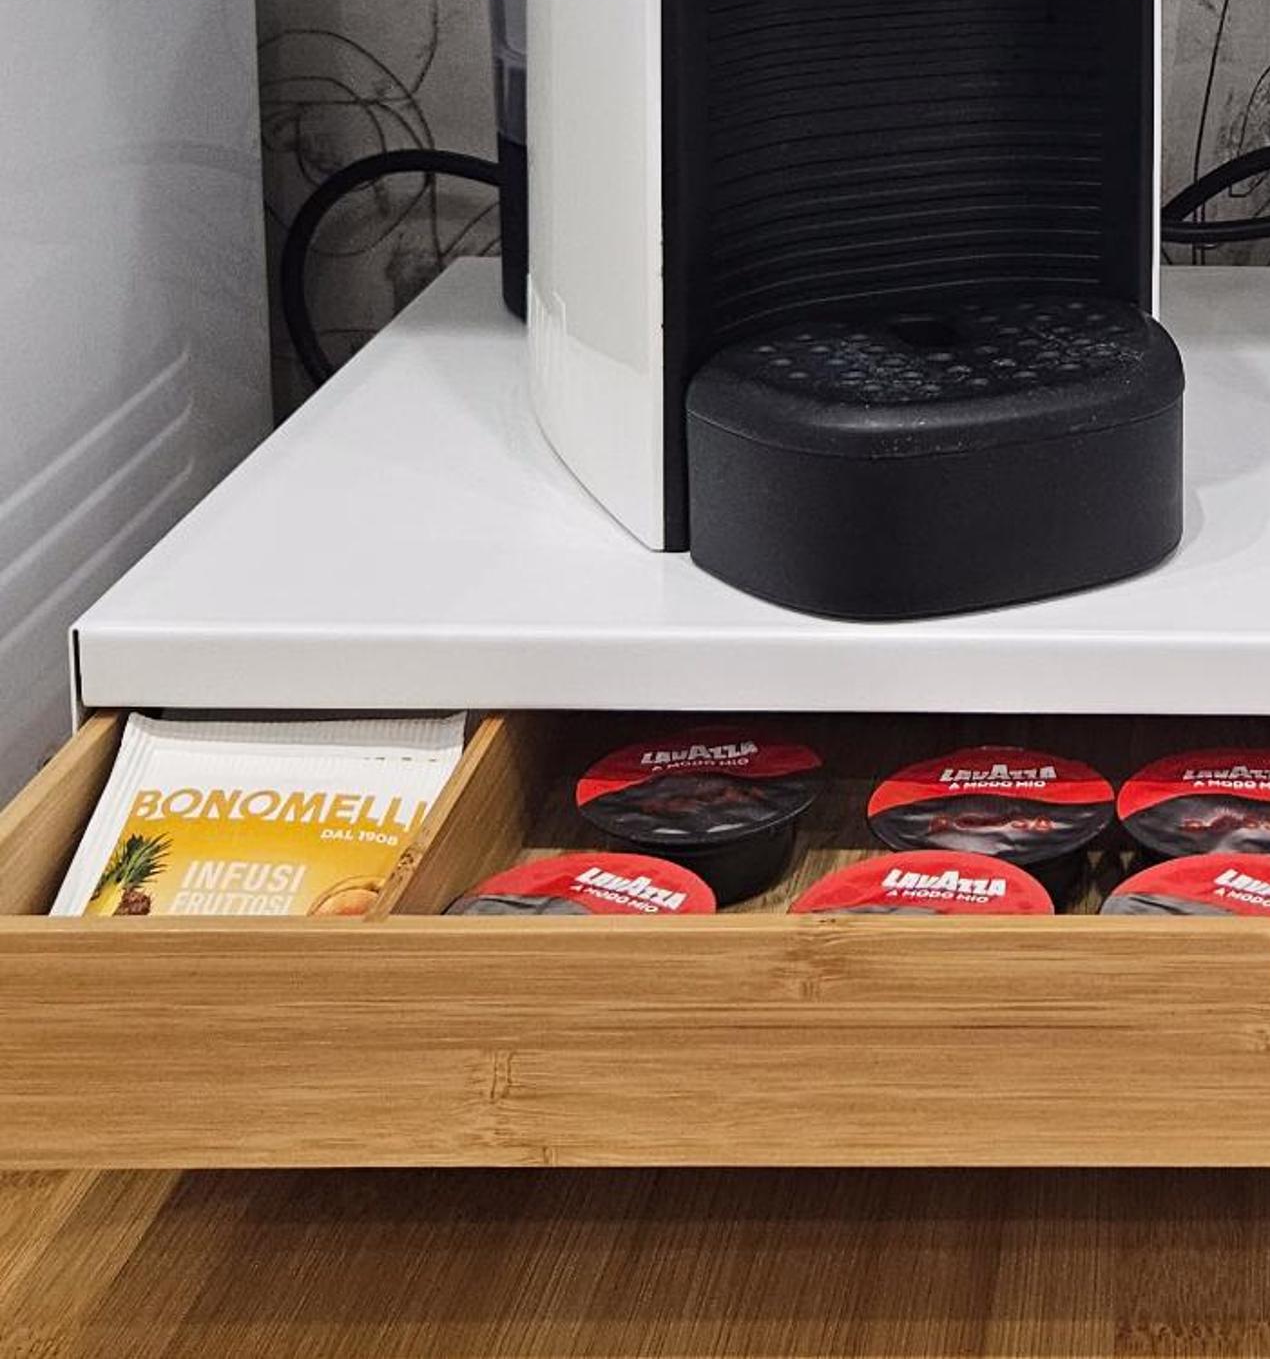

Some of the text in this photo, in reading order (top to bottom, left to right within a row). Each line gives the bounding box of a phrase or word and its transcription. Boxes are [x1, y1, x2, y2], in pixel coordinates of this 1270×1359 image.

[641, 739, 758, 764] LAVAZZA
[939, 764, 1057, 782] LAVAZZA
[948, 782, 960, 790] A
[1015, 780, 1046, 788] MIO
[1193, 780, 1205, 788] A
[1207, 780, 1257, 790] MODO
[131, 788, 428, 831] BONOMELLI
[319, 828, 355, 841] DAL
[181, 860, 307, 892] INFUSI
[882, 868, 1007, 897] LAVAZZA
[570, 884, 659, 914] A MODO MIO
[575, 866, 688, 912] LAVAZZA
[901, 890, 955, 900] MODO
[956, 893, 990, 904] MIO
[1213, 888, 1226, 896] A
